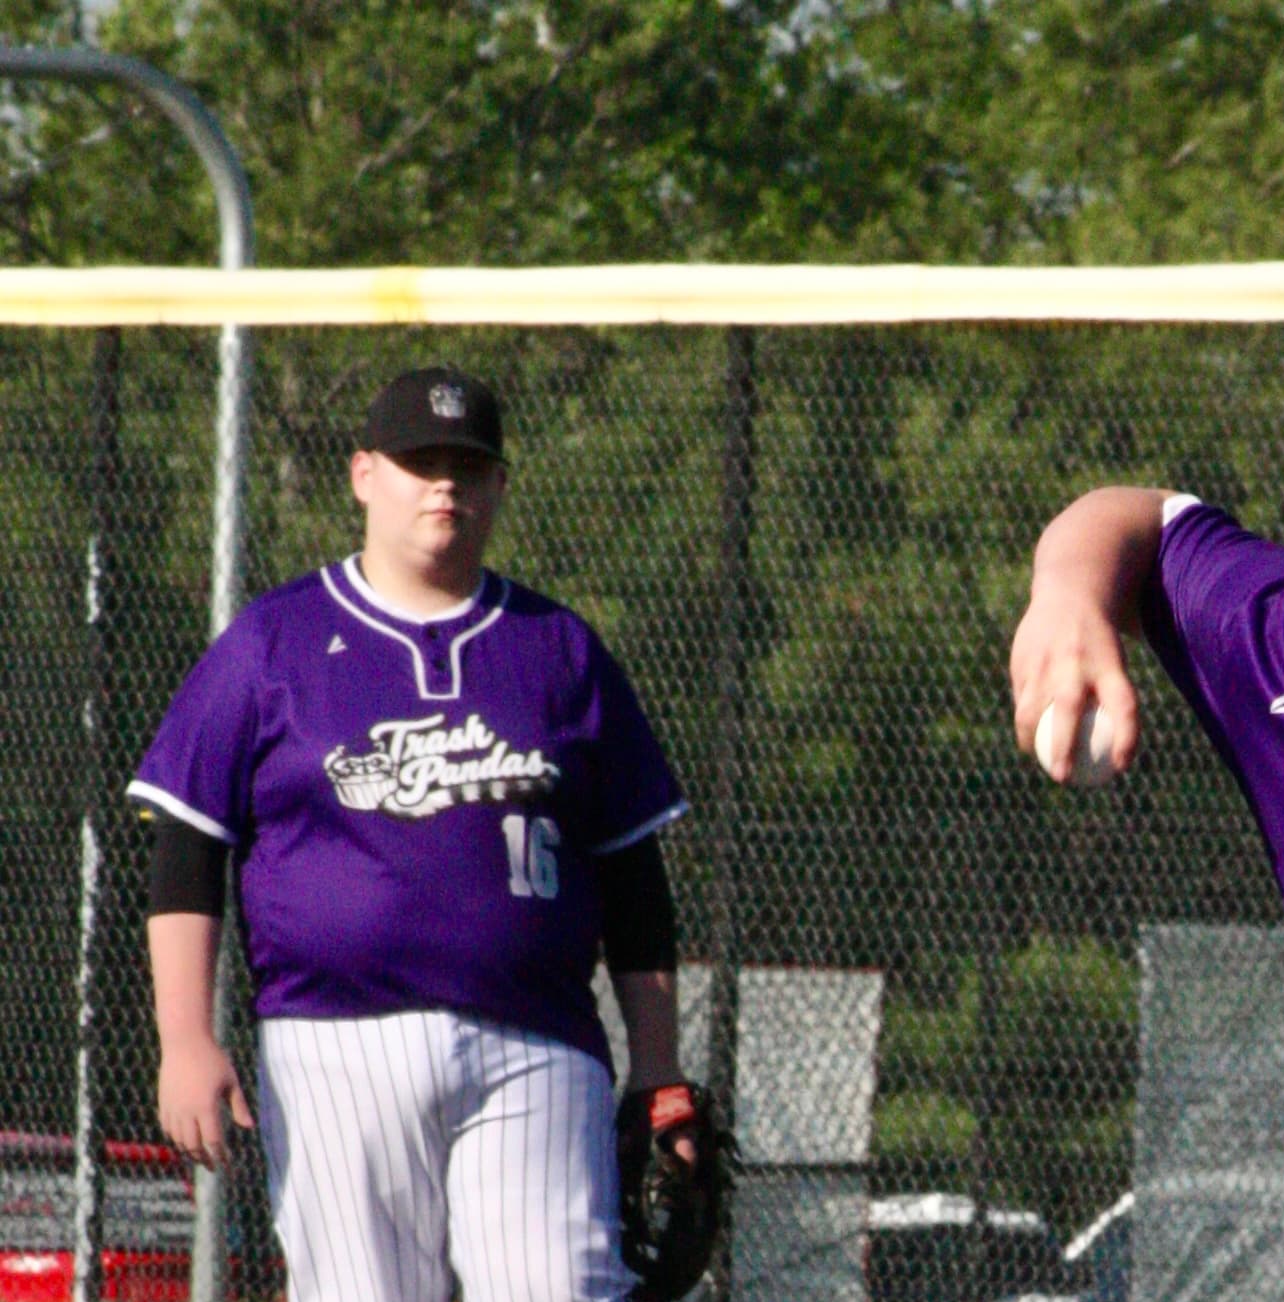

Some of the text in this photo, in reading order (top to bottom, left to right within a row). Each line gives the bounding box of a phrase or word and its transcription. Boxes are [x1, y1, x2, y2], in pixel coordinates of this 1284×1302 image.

[369, 713, 495, 764] Trash
[396, 741, 560, 805] Pandas
[502, 814, 561, 899] 16
